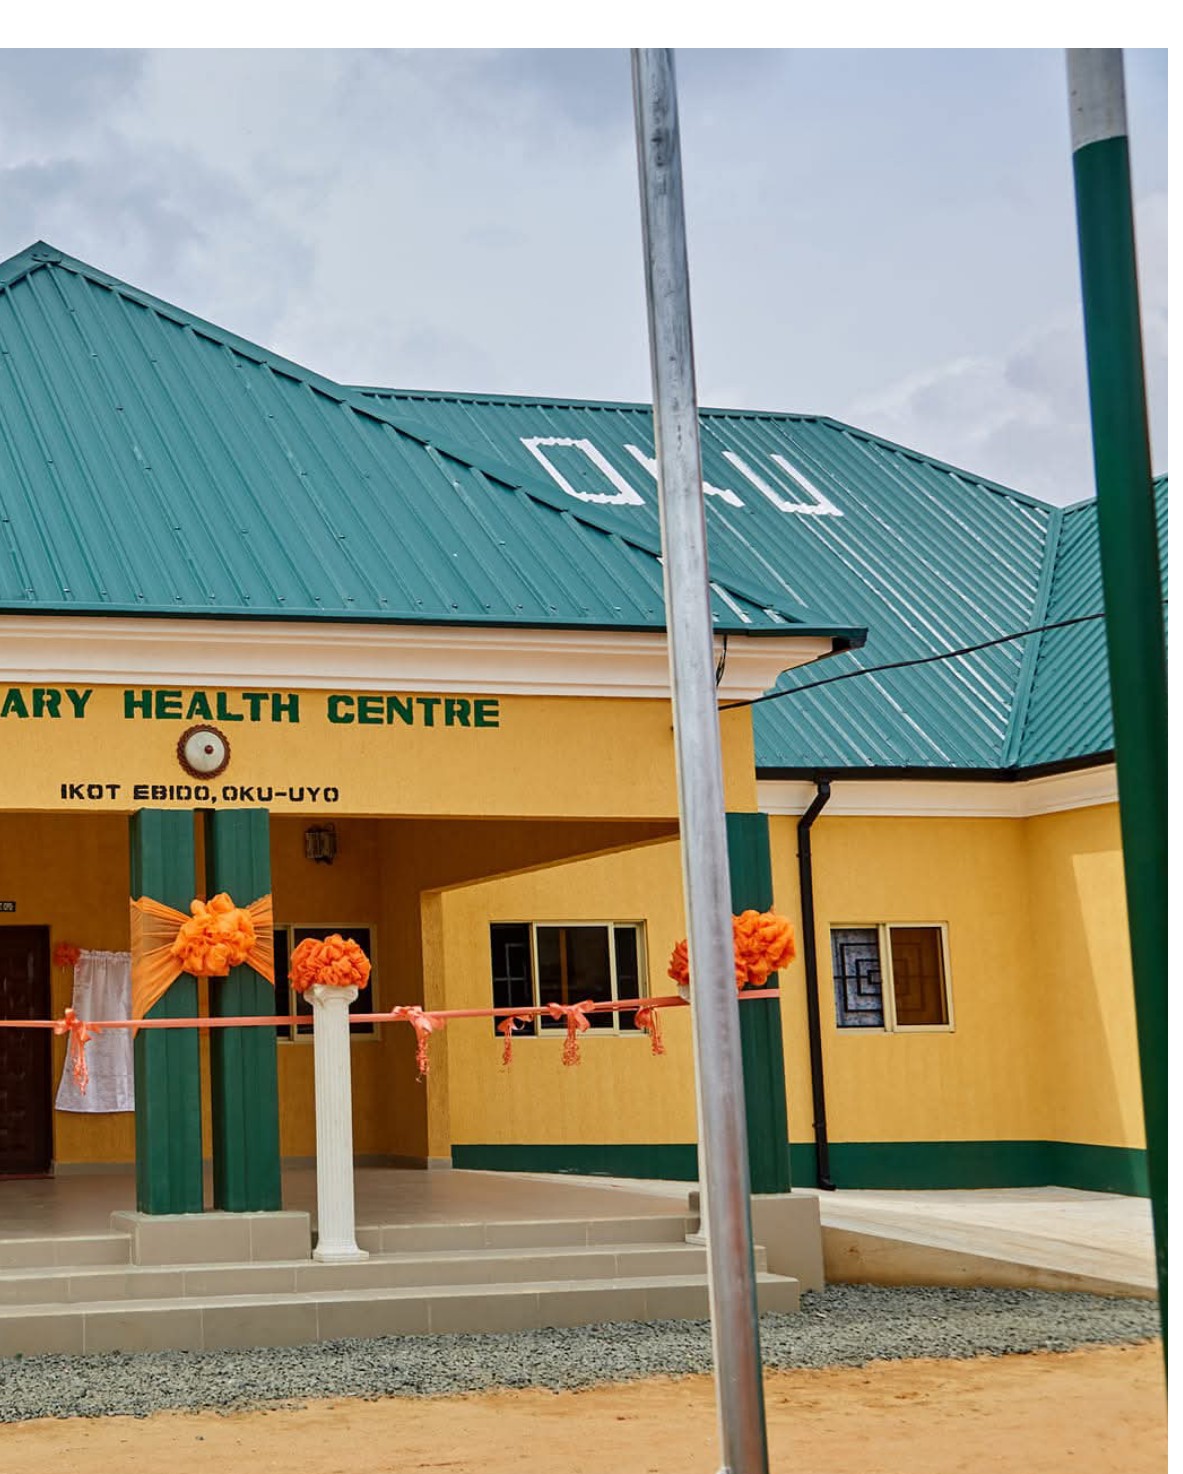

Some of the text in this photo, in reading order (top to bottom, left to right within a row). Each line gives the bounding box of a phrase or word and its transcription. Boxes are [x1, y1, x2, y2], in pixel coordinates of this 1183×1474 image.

[124, 689, 299, 723] HEALTH
[327, 695, 499, 727] CENTRE
[61, 784, 120, 799] IKOT
